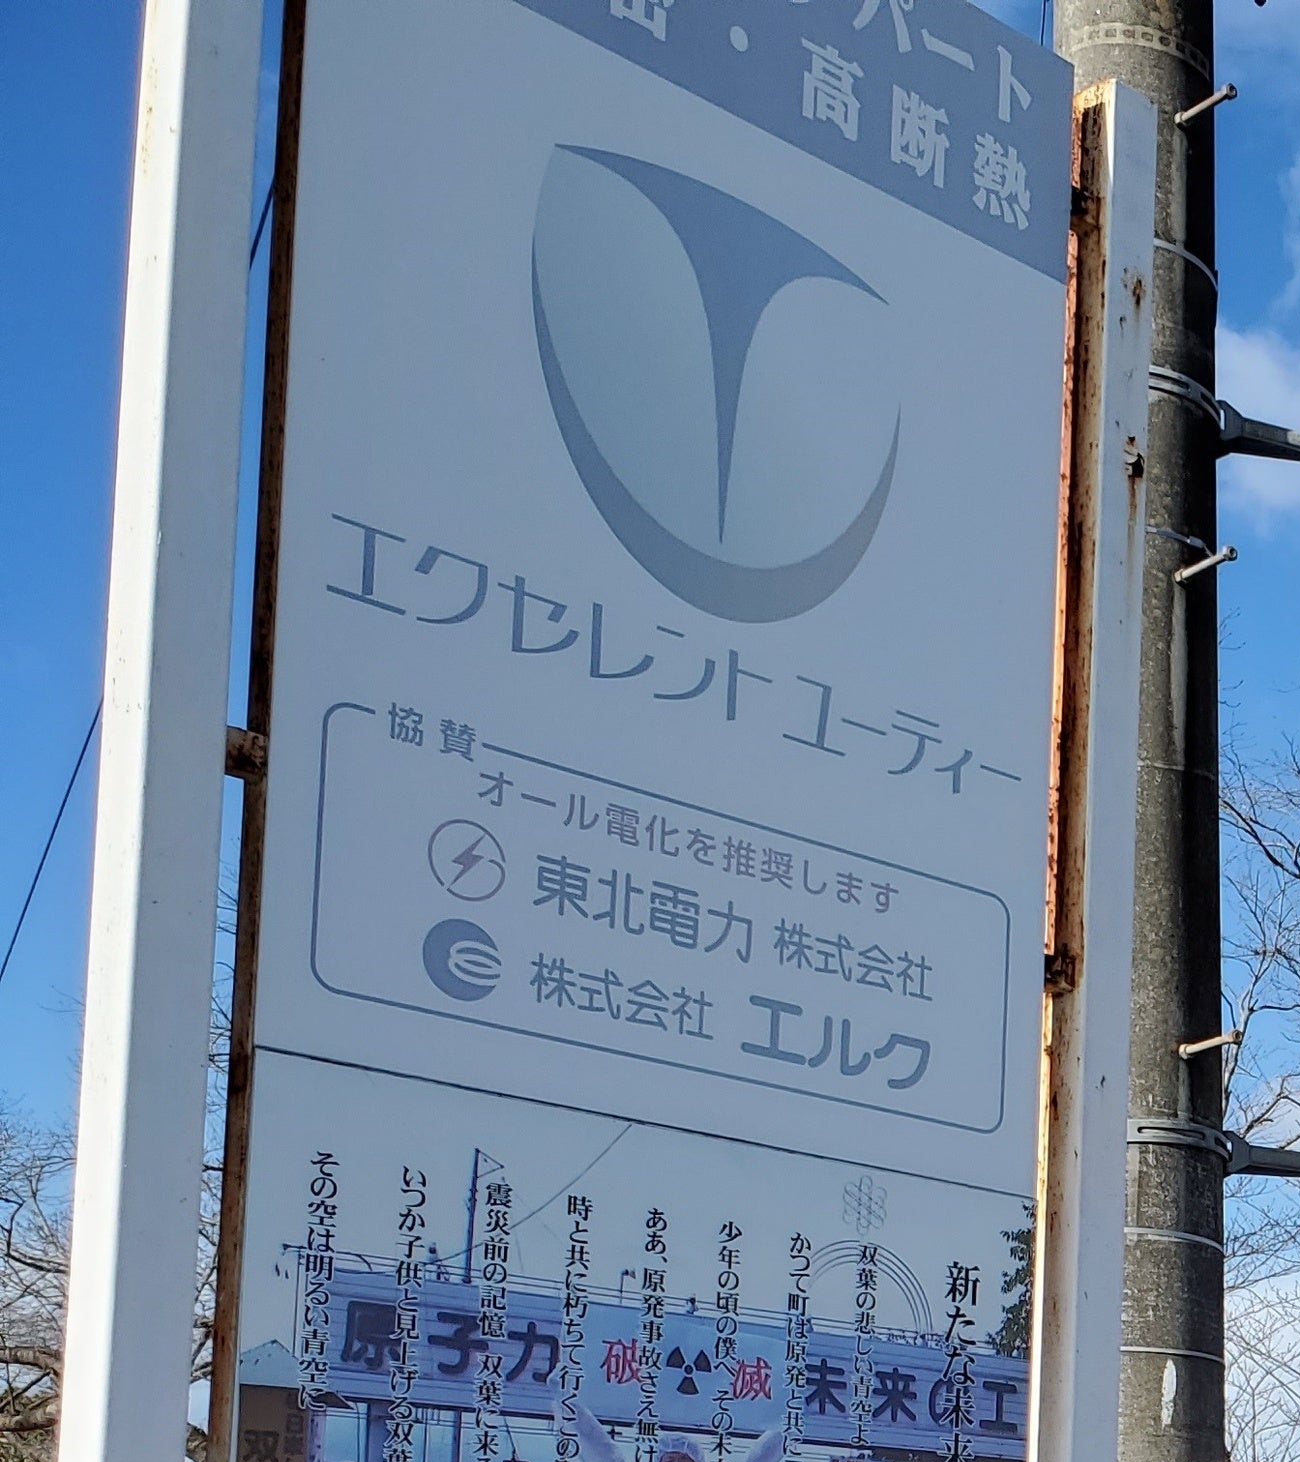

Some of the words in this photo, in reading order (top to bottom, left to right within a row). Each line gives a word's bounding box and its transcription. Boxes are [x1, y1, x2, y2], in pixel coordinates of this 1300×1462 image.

[793, 0, 1032, 123] パート
[326, 512, 773, 721] エクセレント
[782, 674, 1022, 794] ユーティー
[387, 702, 476, 763] 協賛
[477, 771, 900, 914] オール電化を推奨します
[533, 854, 753, 964] 東北電力
[773, 917, 934, 1002] 株式会社
[530, 952, 714, 1041] 株式会社
[740, 994, 932, 1090] エルク
[298, 1151, 341, 1411] その空は明るい青空に
[479, 1182, 513, 1339] 震災前の記憶
[340, 1300, 560, 1384] 原子力
[849, 1245, 879, 1447] 双葉の悲しい青空よ
